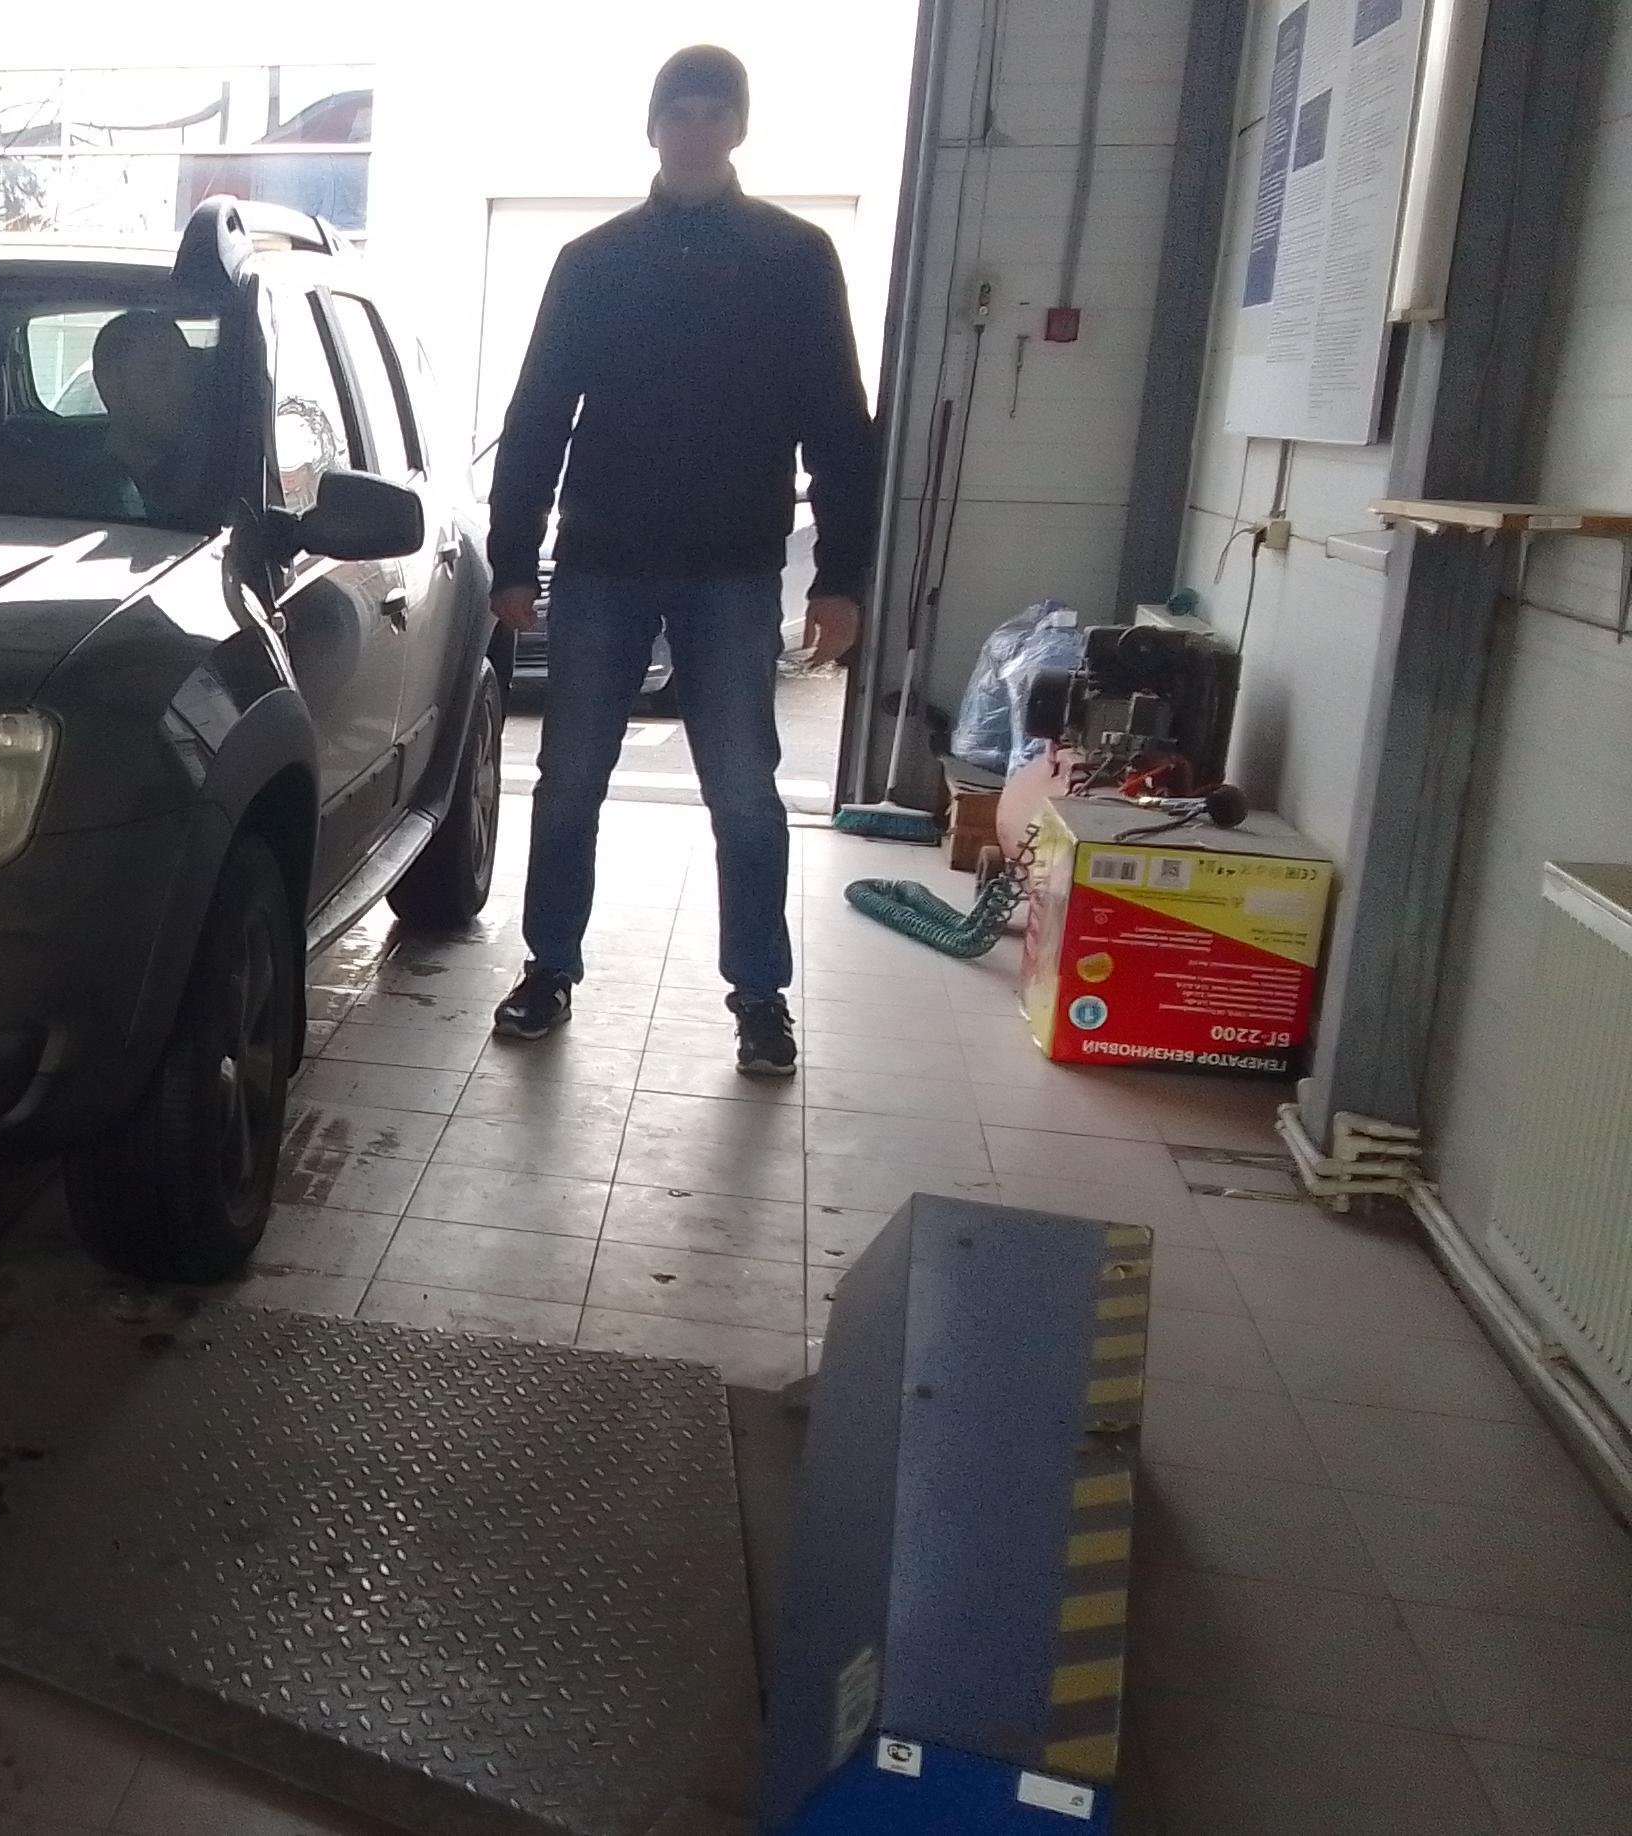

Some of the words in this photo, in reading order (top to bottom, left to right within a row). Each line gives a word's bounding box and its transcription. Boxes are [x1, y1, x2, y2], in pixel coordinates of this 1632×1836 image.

[1211, 1026, 1291, 1047] БГ-2200
[1082, 1039, 1195, 1063] БЕНЗИНОВЫЙ
[1198, 1052, 1287, 1072] ГЕНЕРАТОР
